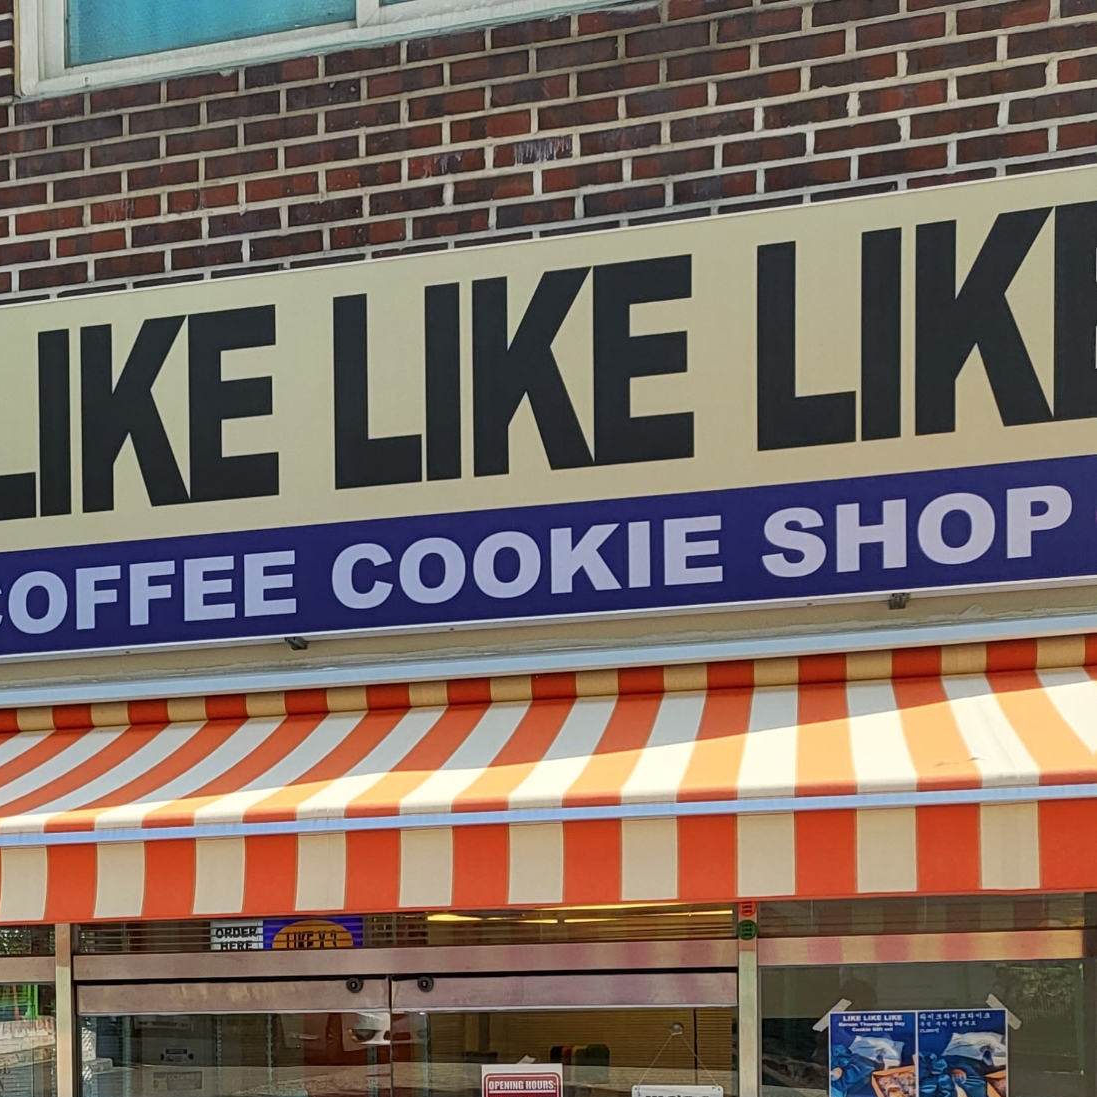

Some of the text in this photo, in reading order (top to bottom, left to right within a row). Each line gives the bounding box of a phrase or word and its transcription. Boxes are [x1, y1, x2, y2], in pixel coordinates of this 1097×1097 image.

[333, 254, 694, 490] LIKE
[332, 515, 723, 609] COOKIE
[762, 485, 1073, 578] SHOP
[215, 927, 257, 939] ORDER
[286, 930, 314, 948] LIKE
[220, 940, 253, 950] HERE
[489, 1080, 556, 1090] OPENING HOURS:
